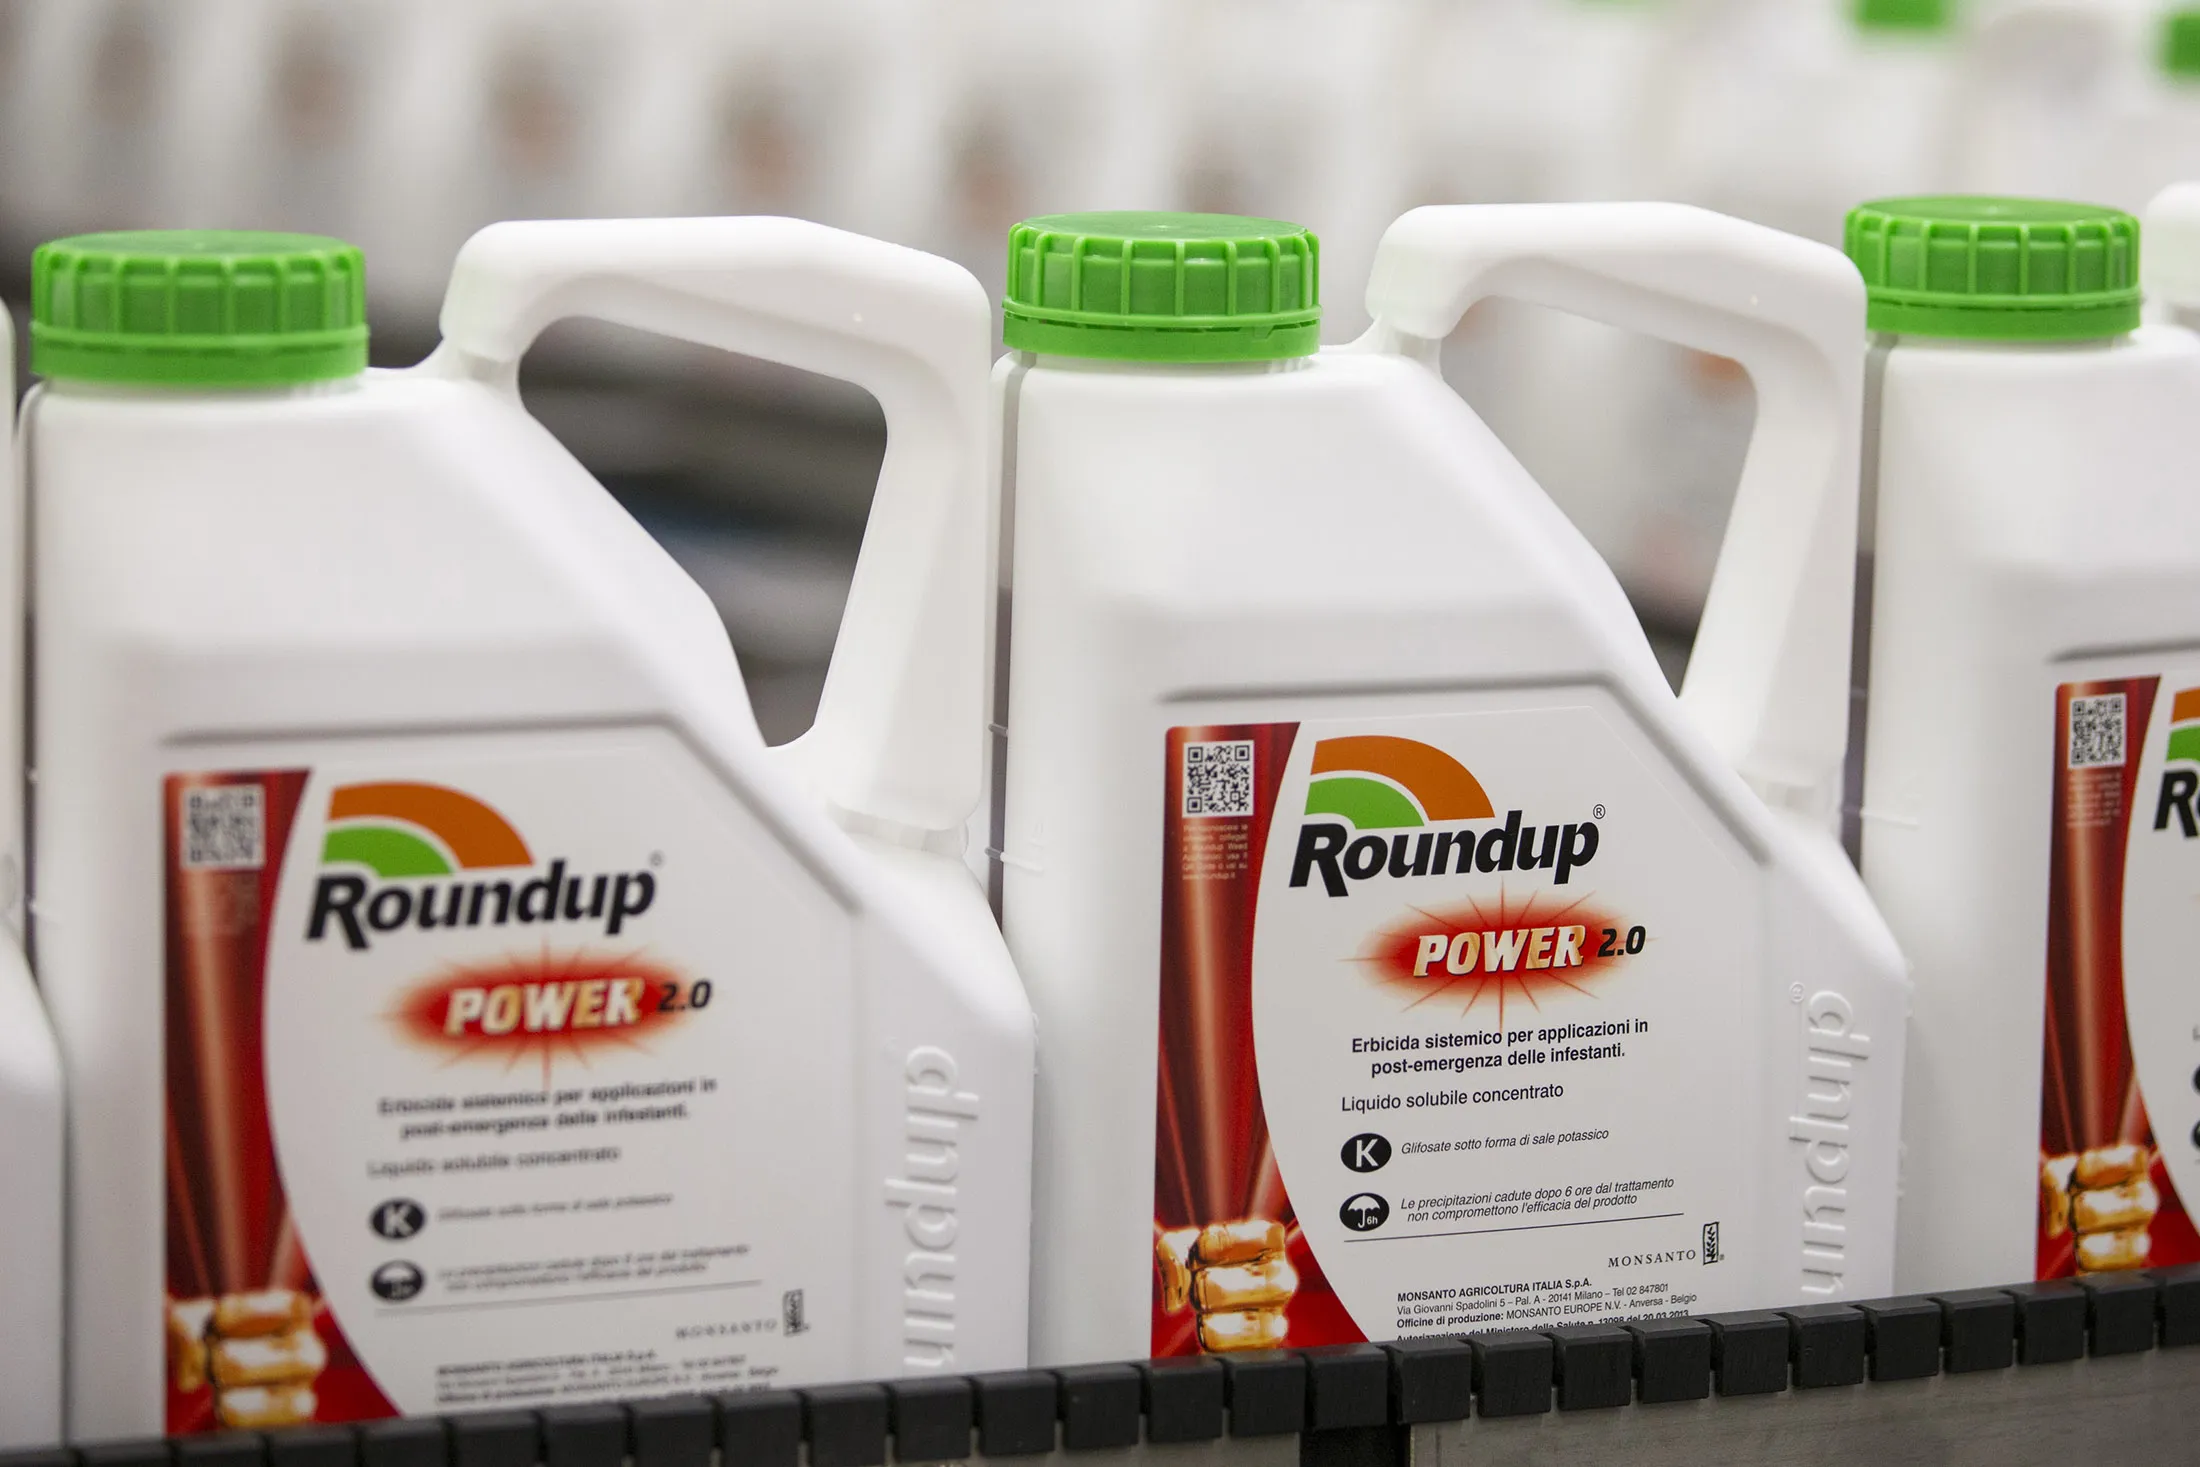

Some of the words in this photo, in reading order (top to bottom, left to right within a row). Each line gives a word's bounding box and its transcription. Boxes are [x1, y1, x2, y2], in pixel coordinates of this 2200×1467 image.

[2152, 770, 2200, 838] R
[305, 858, 656, 951] Roundup
[1413, 925, 1586, 977] POWER
[1597, 925, 1646, 958] 2.0
[445, 977, 645, 1037] POWER
[657, 979, 712, 1013] 2.0
[1352, 1035, 1419, 1053] Erbicida
[1425, 1032, 1502, 1049] sistemico
[1508, 1030, 1533, 1047] per
[1538, 1020, 1629, 1044] applicazioni
[1635, 1019, 1648, 1034] in
[1372, 1055, 1502, 1078] post-emergenza
[1508, 1049, 1545, 1066] delle
[1551, 1043, 1624, 1062] infestanti.
[1342, 1094, 1401, 1114] Liquido
[1406, 1090, 1467, 1108] solubile
[1473, 1084, 1563, 1103] concentrato
[1356, 1138, 1379, 1168] K
[1402, 1141, 1451, 1154] Glifosate
[1454, 1139, 1481, 1150] sotto
[1485, 1137, 1516, 1148] forma
[1520, 1134, 1530, 1146] di
[1532, 1133, 1555, 1144] sale
[1557, 1129, 1609, 1145] potassico
[1789, 990, 1870, 1295] undup
[884, 1045, 979, 1367] undup
[1401, 1198, 1415, 1209] Le
[1418, 1192, 1492, 1211] precipitazioni
[1494, 1190, 1531, 1203] cadute
[1535, 1188, 1562, 1201] dopo
[1565, 1186, 1572, 1197] 6
[1575, 1186, 1592, 1195] ore
[1596, 1182, 1612, 1194] dal
[1615, 1178, 1674, 1192] trattamento
[1408, 1212, 1429, 1222] non
[1432, 1205, 1518, 1221] compromettono
[1522, 1200, 1571, 1213] l'efficacia
[1574, 1198, 1591, 1209] del
[1593, 1195, 1637, 1210] prodotto
[382, 1201, 414, 1235] K
[1366, 1216, 1378, 1225] 6h
[1608, 1250, 1696, 1267] MONSANTO
[1397, 1306, 1411, 1315] Via
[1414, 1302, 1453, 1314] Giovanni
[1456, 1299, 1497, 1312] Spadolini
[1500, 1298, 1505, 1307] 5
[1515, 1296, 1531, 1306] Pal.
[1534, 1295, 1540, 1304] A
[1548, 1292, 1571, 1303] 20141
[1575, 1291, 1603, 1300] Milano
[1612, 1287, 1624, 1296] Tel
[1626, 1286, 1637, 1296] 02
[1639, 1284, 1668, 1294] 847801
[1398, 1289, 1456, 1302] MONSANTO
[1459, 1283, 1530, 1297] AGRICOLTURA
[1533, 1280, 1563, 1291] ITALIA
[1565, 1278, 1592, 1289] S.p.A.
[1397, 1318, 1433, 1328] Officine
[1436, 1316, 1445, 1325] di
[1448, 1313, 1503, 1326] produzione:
[1506, 1306, 1561, 1319] MONSANTO
[1564, 1302, 1602, 1314] EUROPE
[1605, 1301, 1621, 1310] N.V.
[1629, 1298, 1663, 1308] Anversa
[1671, 1295, 1697, 1304] Belgio
